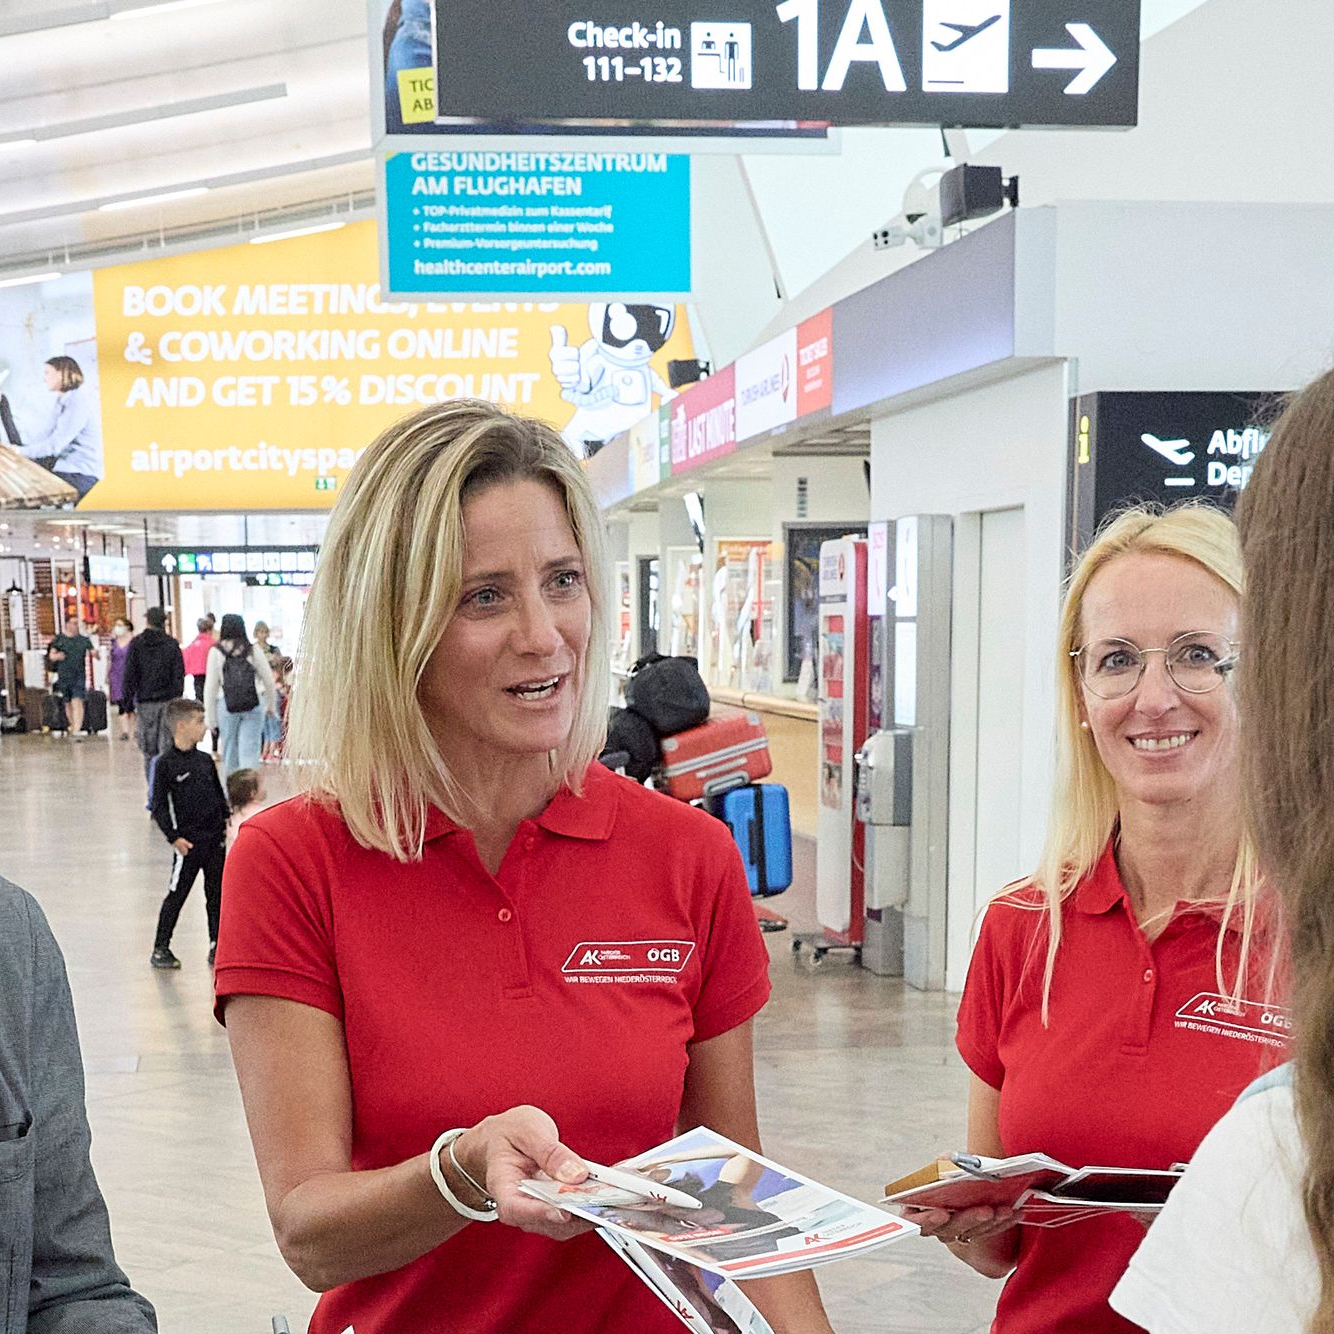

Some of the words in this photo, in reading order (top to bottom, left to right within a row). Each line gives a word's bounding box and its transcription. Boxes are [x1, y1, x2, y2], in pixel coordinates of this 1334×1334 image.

[567, 21, 681, 49] Check-in
[775, 0, 907, 92] 1A
[411, 152, 668, 173] GESUNDHEITSZENTRUM
[411, 176, 448, 195] AM
[454, 175, 582, 195] FLUGHAFEN
[414, 258, 612, 278] healthcenterairport.com
[123, 285, 226, 317] BOOK
[124, 332, 153, 365] &
[158, 329, 380, 362] COWORKING
[387, 328, 519, 360] ONLINE
[126, 376, 206, 408] AND
[212, 375, 281, 407] GET
[359, 372, 540, 406] DISCOUNT
[1207, 428, 1272, 459] Abfl
[1207, 461, 1253, 490] Dep
[579, 949, 602, 965] AK
[1194, 1000, 1216, 1016] AK
